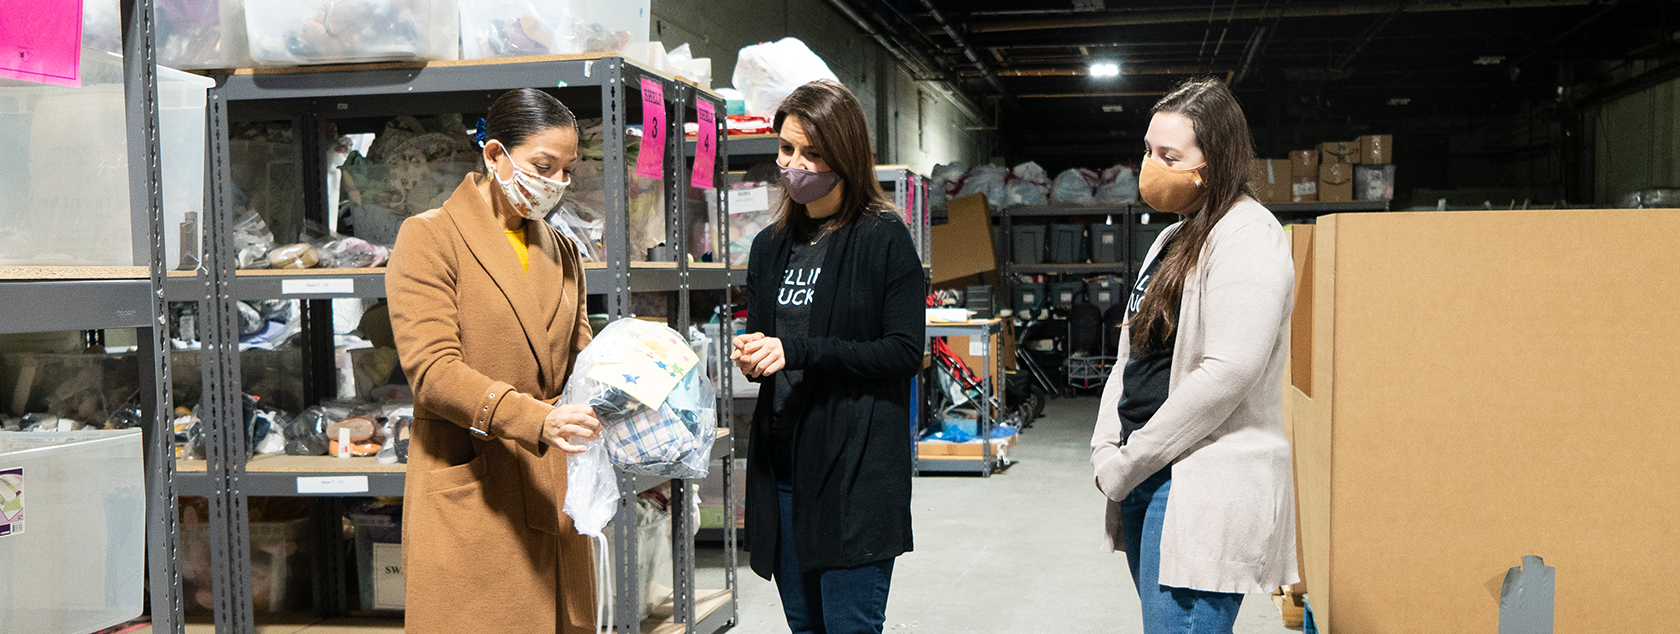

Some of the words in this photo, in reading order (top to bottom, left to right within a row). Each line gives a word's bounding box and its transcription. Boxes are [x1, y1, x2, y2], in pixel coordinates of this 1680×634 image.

[644, 88, 661, 106] SHELF
[652, 117, 658, 138] 3
[704, 134, 709, 152] 4
[778, 288, 814, 306] UCK
[385, 566, 404, 575] SW
